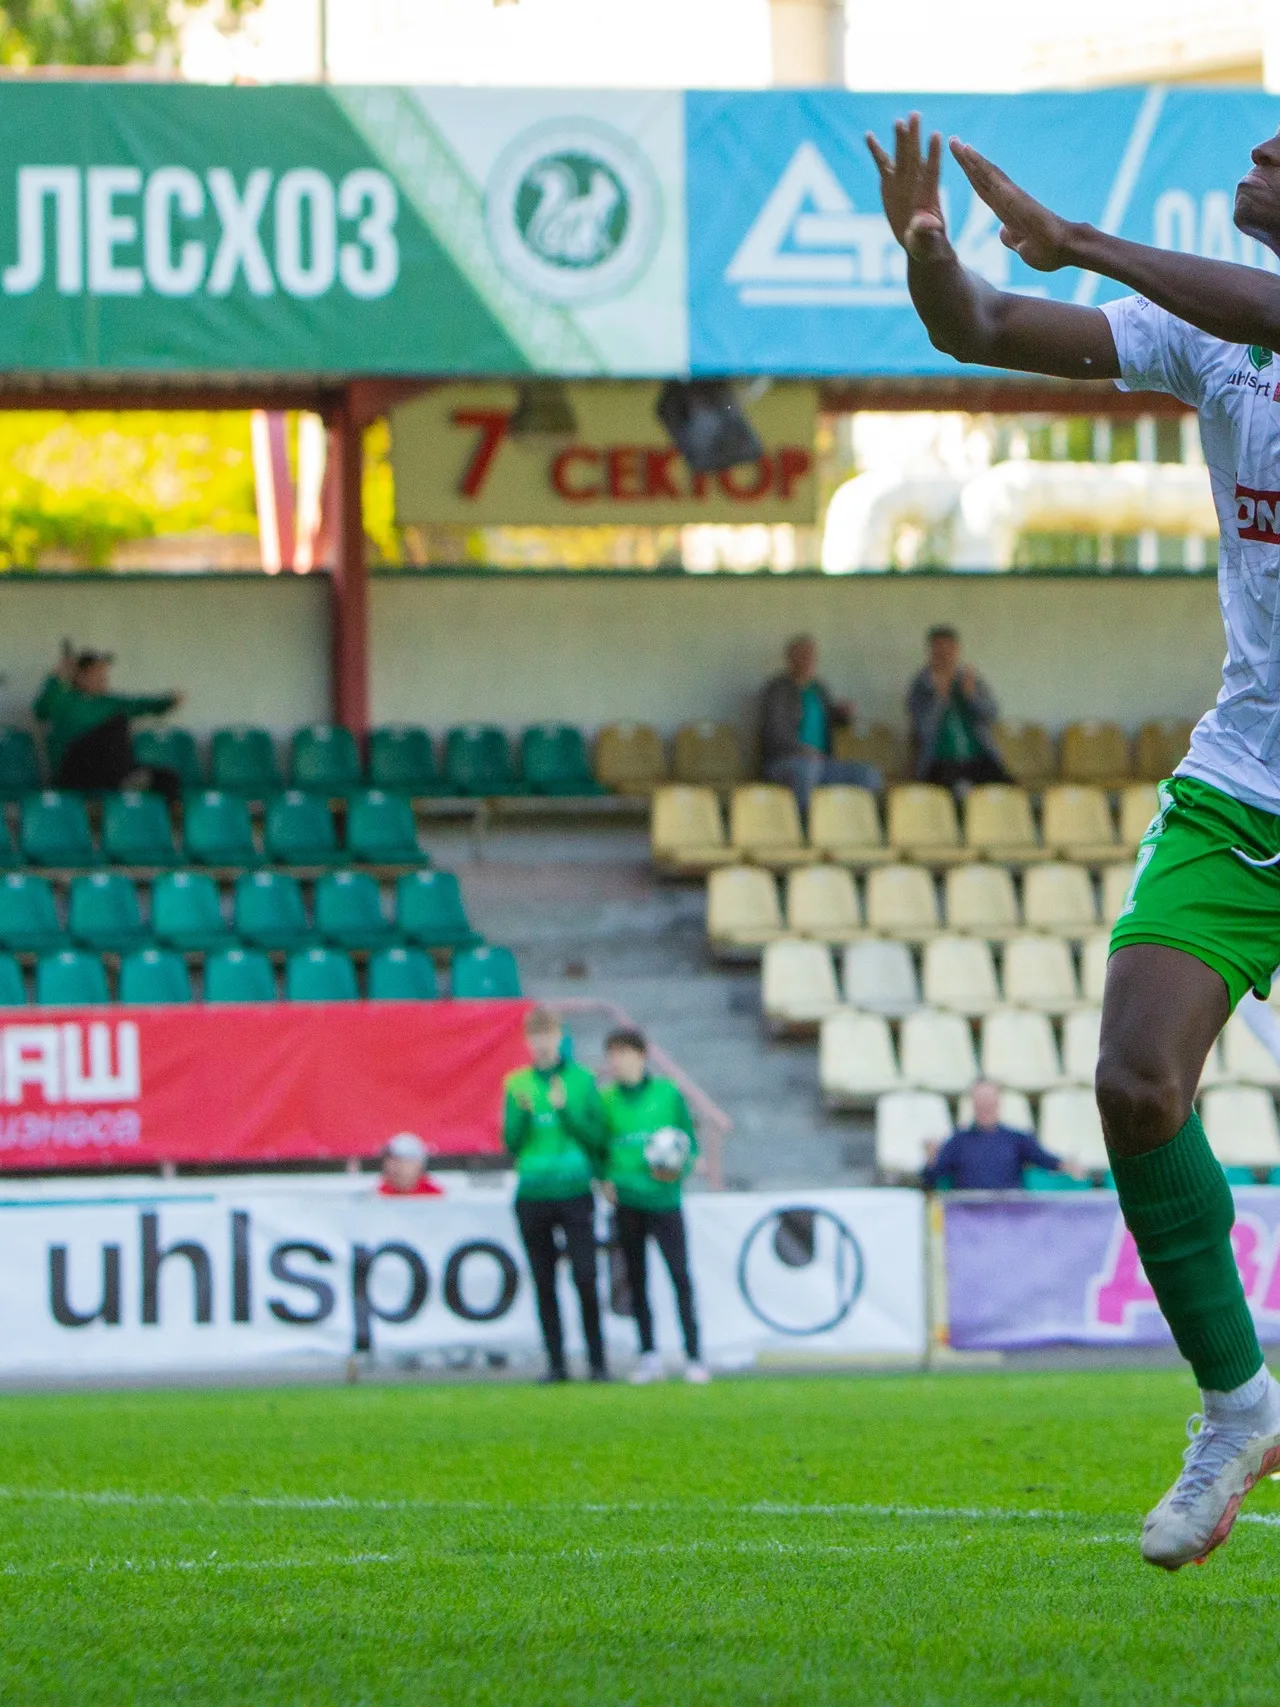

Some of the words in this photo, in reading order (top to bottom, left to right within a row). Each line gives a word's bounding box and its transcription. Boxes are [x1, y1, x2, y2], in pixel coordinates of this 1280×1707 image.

[2, 164, 401, 296] ЛЕСХОЗ
[451, 406, 513, 500] 7
[1, 1020, 142, 1105] АШ
